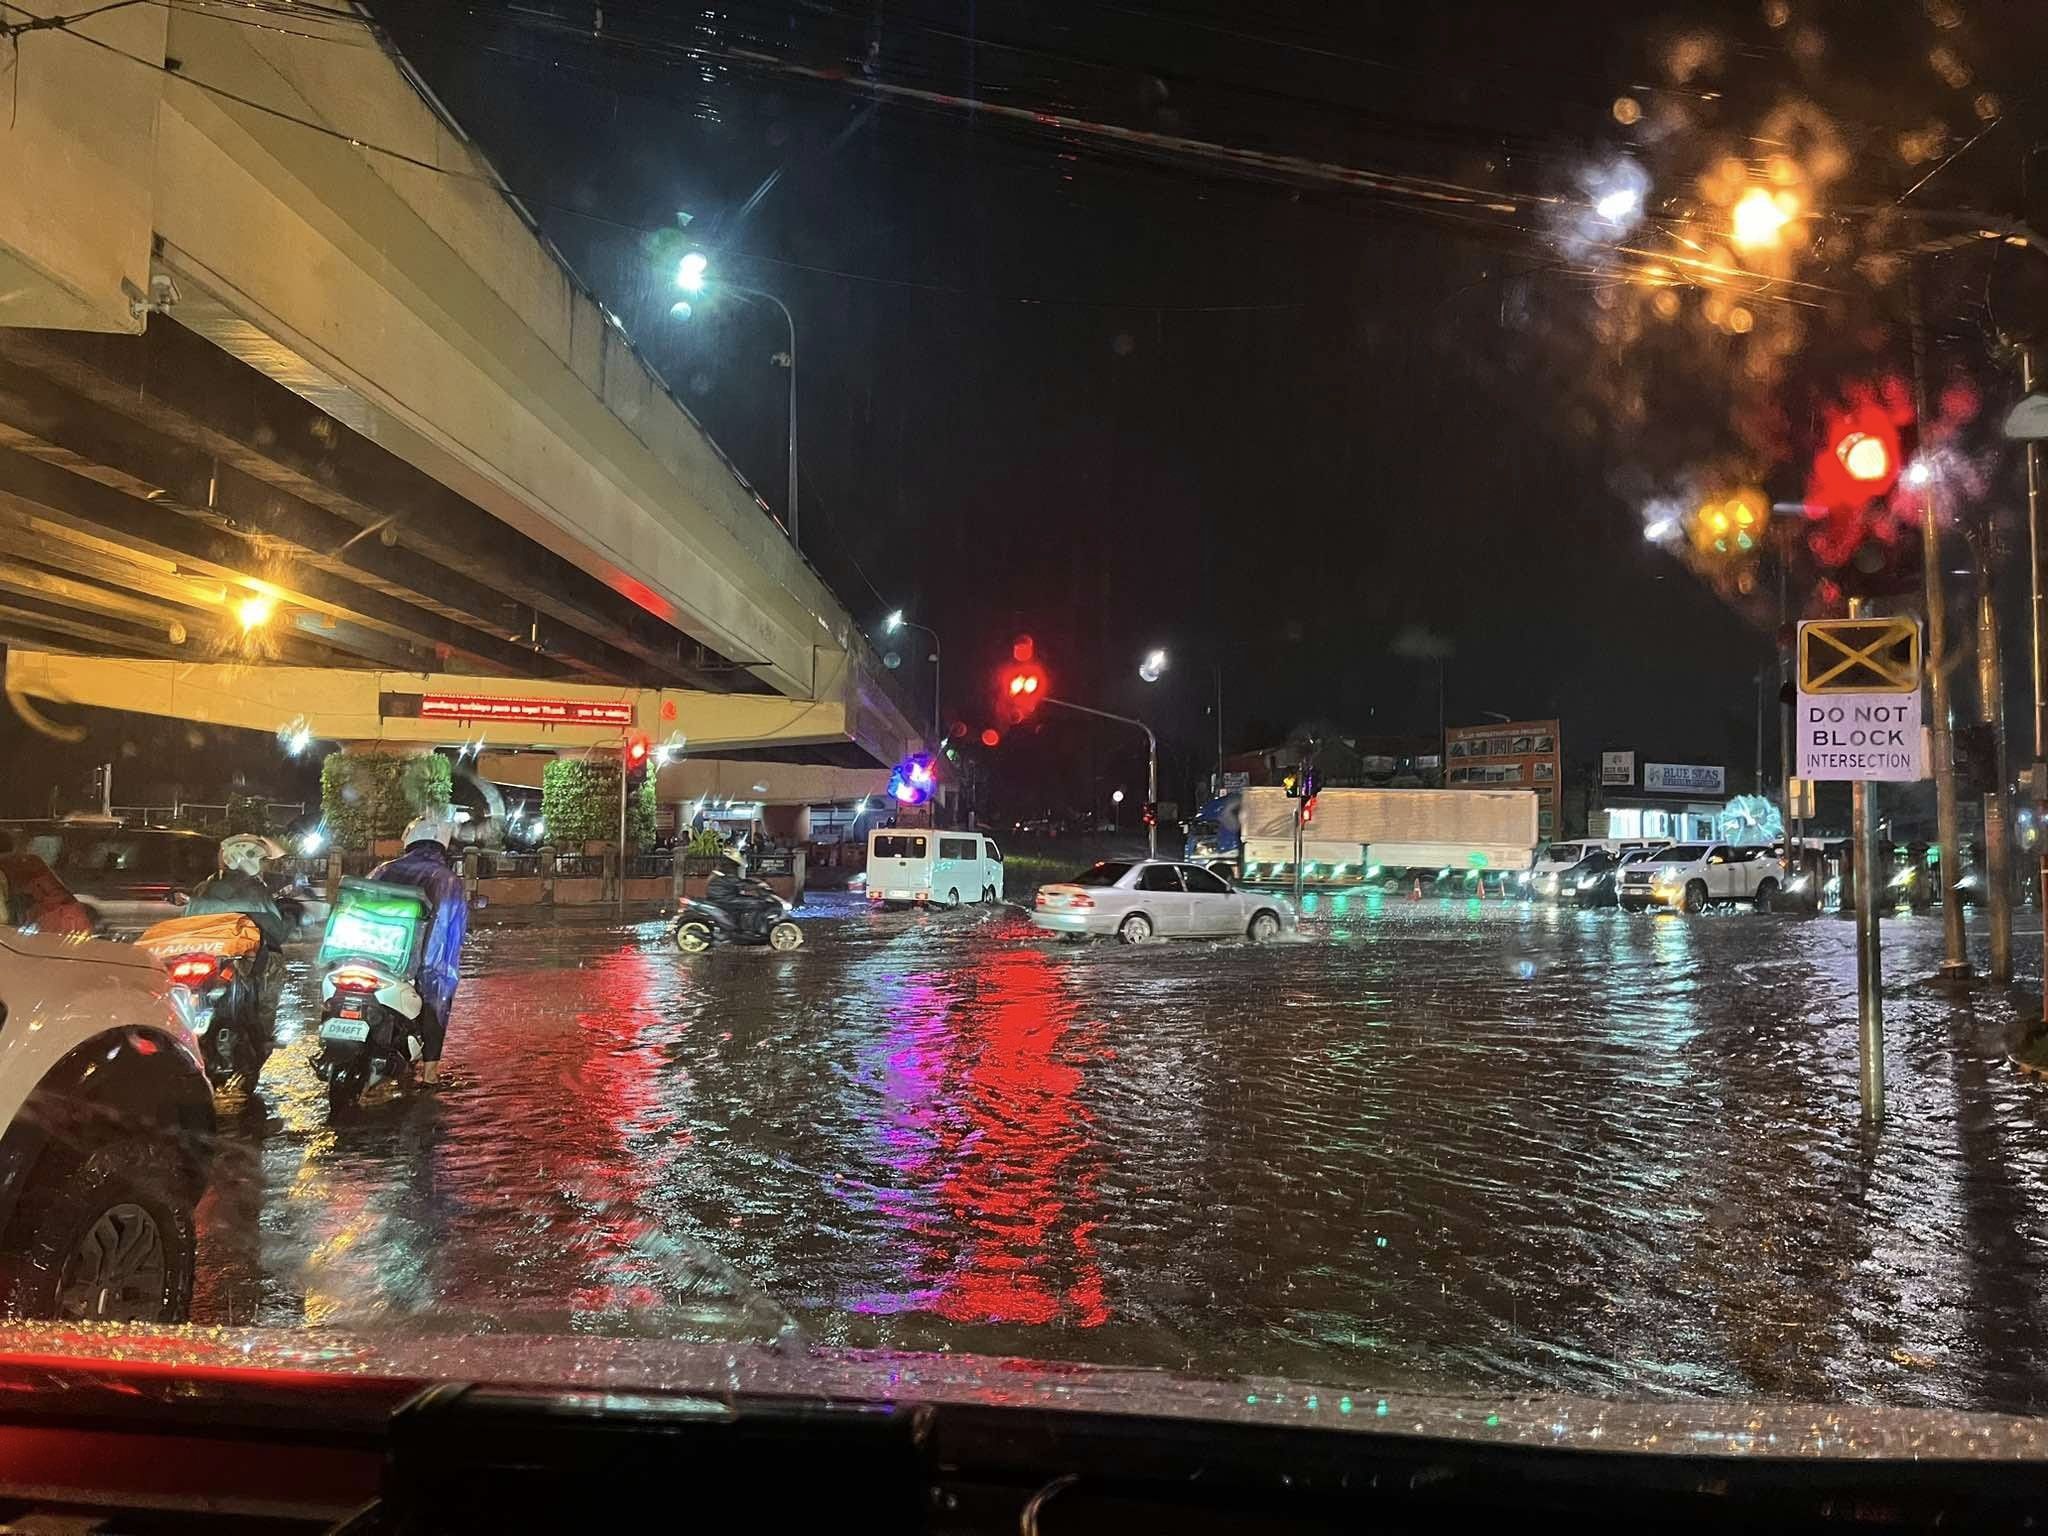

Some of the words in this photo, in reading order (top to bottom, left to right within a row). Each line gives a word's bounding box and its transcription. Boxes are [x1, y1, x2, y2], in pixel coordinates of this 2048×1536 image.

[577, 709, 593, 717] you
[1810, 707, 1845, 723] DO
[1855, 706, 1908, 723] NOT
[1812, 730, 1905, 746] BLOCK
[1807, 753, 1911, 768] INTERSECTION
[1663, 767, 1690, 779] BLUE
[1691, 768, 1719, 780] SEAS
